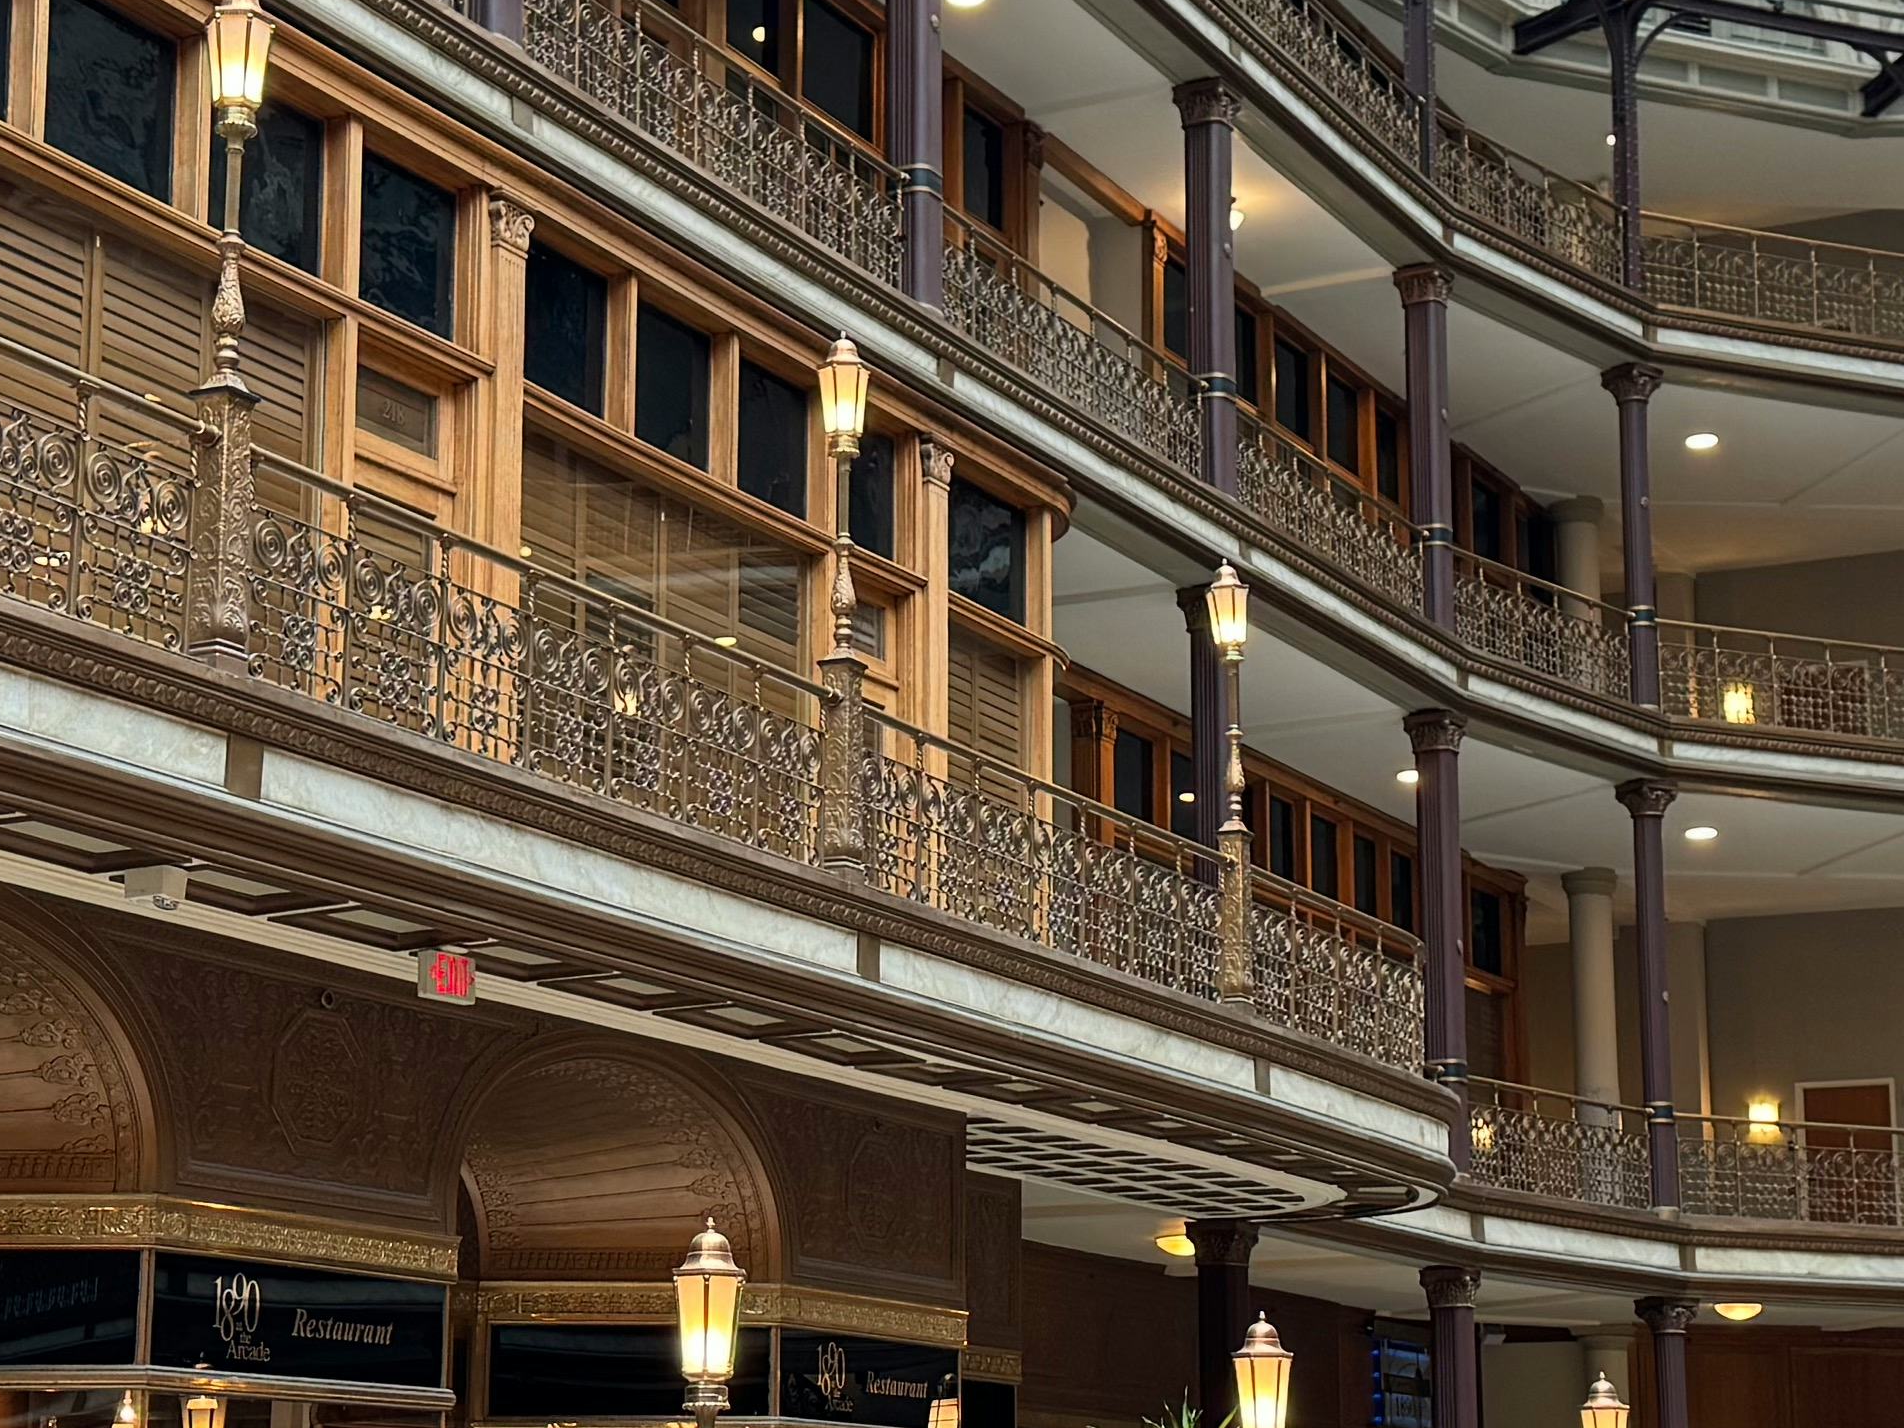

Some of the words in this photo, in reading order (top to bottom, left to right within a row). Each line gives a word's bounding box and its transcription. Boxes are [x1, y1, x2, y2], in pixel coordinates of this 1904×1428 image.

[435, 952, 468, 997] EXIT
[212, 1272, 261, 1342] 1890
[291, 1308, 393, 1345] Restaurant
[226, 1339, 271, 1362] Arcade
[865, 1370, 928, 1399] Restaurant
